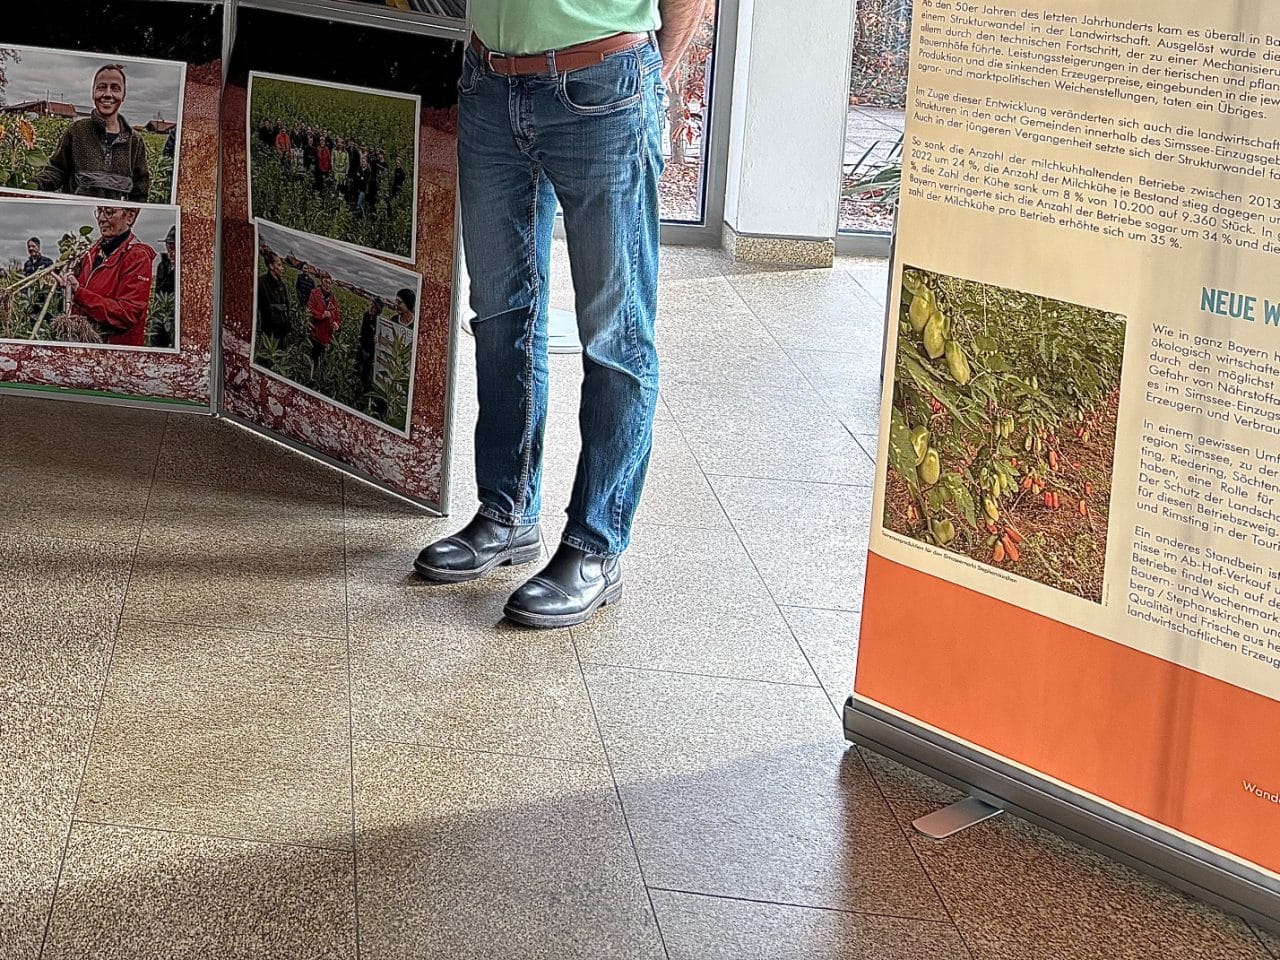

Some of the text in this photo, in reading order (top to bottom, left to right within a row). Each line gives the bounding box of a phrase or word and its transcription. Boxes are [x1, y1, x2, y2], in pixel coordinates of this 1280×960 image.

[921, 10, 945, 22] einem
[950, 13, 1025, 31] Strukturwandel
[1031, 23, 1040, 33] in
[1045, 24, 1064, 35] der
[1069, 27, 1150, 46] Landwirtschaft.
[1156, 37, 1214, 53] Ausgelöst
[1219, 47, 1256, 58] wurde
[935, 0, 951, 10] den
[955, 1, 978, 13] 50er
[982, 4, 1016, 17] Jahren
[1020, 8, 1039, 19] des
[1043, 11, 1077, 23] letzten
[1081, 15, 1152, 32] Jahrhunderts
[1157, 23, 1182, 35] kam
[1186, 29, 1200, 37] es
[1204, 28, 1244, 41] überall
[1249, 33, 1260, 43] in
[920, 23, 941, 34] allem
[945, 26, 971, 38] durch
[976, 30, 995, 41] den
[1000, 33, 1060, 49] technischen
[1066, 40, 1121, 58] Fortschritt,
[1126, 48, 1145, 59] der
[1149, 53, 1162, 61] zu
[1167, 53, 1198, 65] einer
[912, 136, 921, 147] So
[924, 141, 945, 151] sank
[949, 143, 964, 154] die
[968, 146, 1003, 161] Anzahl
[1008, 153, 1026, 165] der
[1031, 158, 1132, 183] milchkuhhaltenden
[1138, 175, 1185, 192] Betriebe
[1190, 187, 1242, 202] zwischen
[908, 187, 1182, 248] zahl der Milchkühe pro Betrieb erhöhte sich um 35 %.
[1201, 286, 1256, 321] NEUE
[1151, 336, 1210, 359] ökologisch
[1152, 322, 1268, 359] Wie in ganz Bayern
[1146, 380, 1159, 389] es
[1165, 382, 1179, 394] im
[1148, 363, 1189, 382] Gefahr
[1192, 377, 1213, 388] von
[1149, 350, 1274, 388] durch den möglichst
[1146, 391, 1202, 414] Erzeugern
[1207, 409, 1229, 421] und
